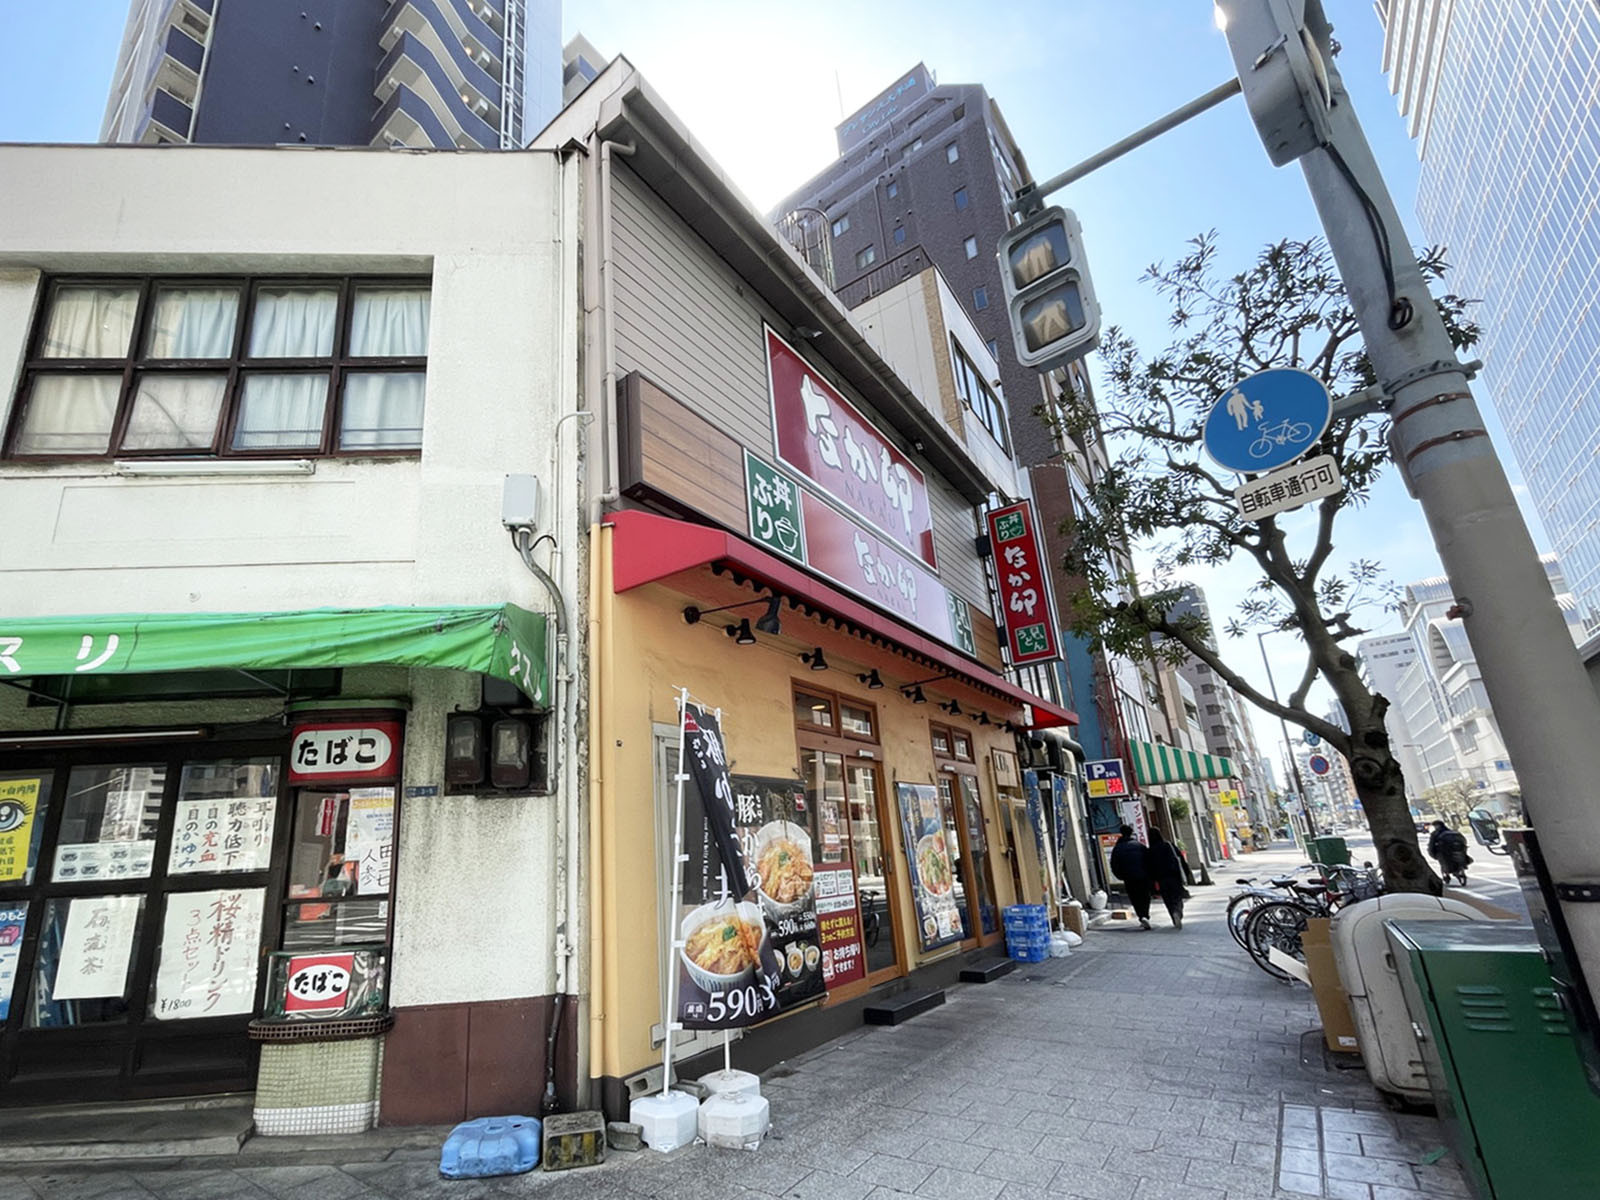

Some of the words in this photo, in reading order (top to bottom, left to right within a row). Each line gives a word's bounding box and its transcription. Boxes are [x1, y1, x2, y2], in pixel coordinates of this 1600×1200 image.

[801, 373, 913, 540] なか卯
[1240, 463, 1334, 514] 自転車通行可
[854, 532, 917, 615] なか卯
[1004, 546, 1037, 617] なか卯
[297, 736, 377, 766] たばこ
[1092, 764, 1106, 779] P
[199, 807, 219, 863] 目の充血
[223, 801, 247, 866] 聴力低下
[161, 998, 192, 1013] ¥1800
[294, 970, 344, 995] たばこ
